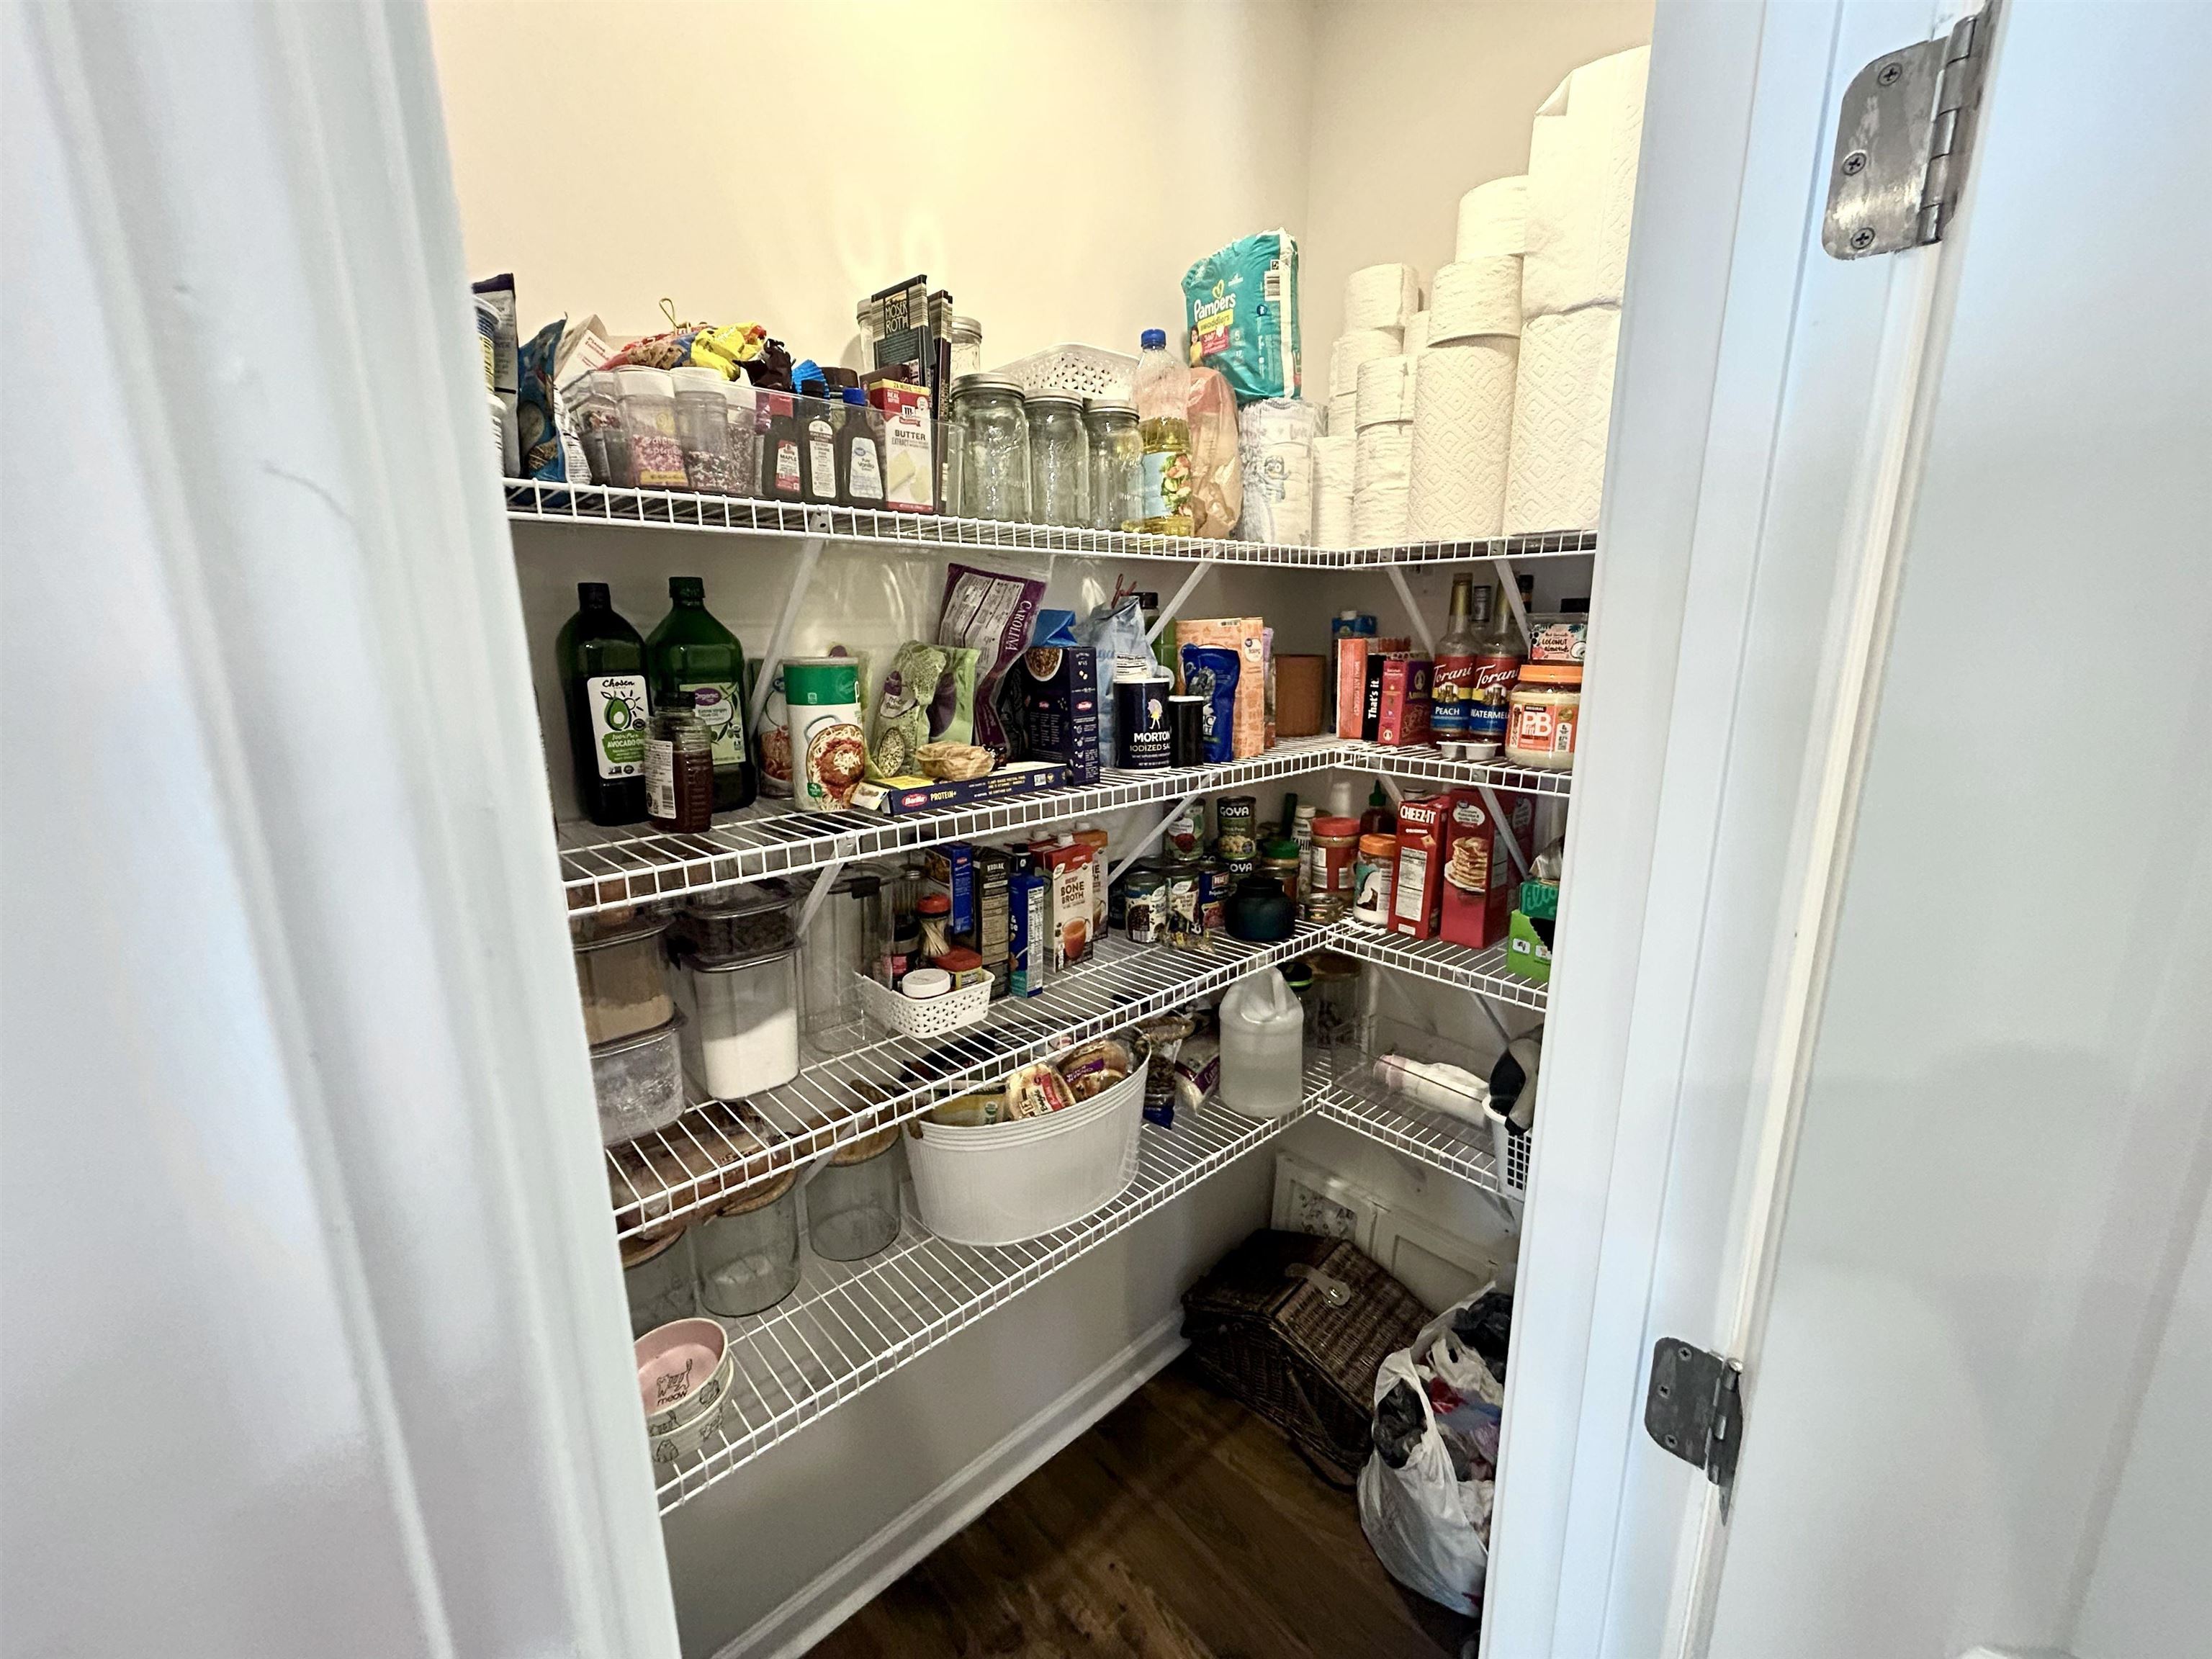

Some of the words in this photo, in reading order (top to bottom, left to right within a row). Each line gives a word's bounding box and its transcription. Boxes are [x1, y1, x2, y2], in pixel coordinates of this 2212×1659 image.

[885, 300, 908, 320] MOSER
[1194, 293, 1236, 322] Pampers
[886, 315, 909, 334] ROTH
[895, 429, 925, 441] BUTTER
[1005, 601, 1032, 650] CAROLINA
[602, 678, 634, 687] Chosen
[1433, 663, 1473, 688] Torani
[1368, 691, 1379, 719] That's
[1435, 706, 1460, 715] PEACH
[1470, 709, 1509, 719] WATERMEL
[1521, 711, 1552, 736] PB
[607, 739, 636, 748] AVOCADO
[904, 796, 926, 805] Barilla
[930, 791, 956, 801] PROTEIN+
[1220, 806, 1249, 817] GOYA
[1400, 805, 1437, 824] CHEEZ-IT
[1229, 863, 1253, 872] OYA
[1061, 881, 1084, 896] BONE
[1061, 891, 1084, 904] BROTH
[657, 1390, 688, 1406] meow
